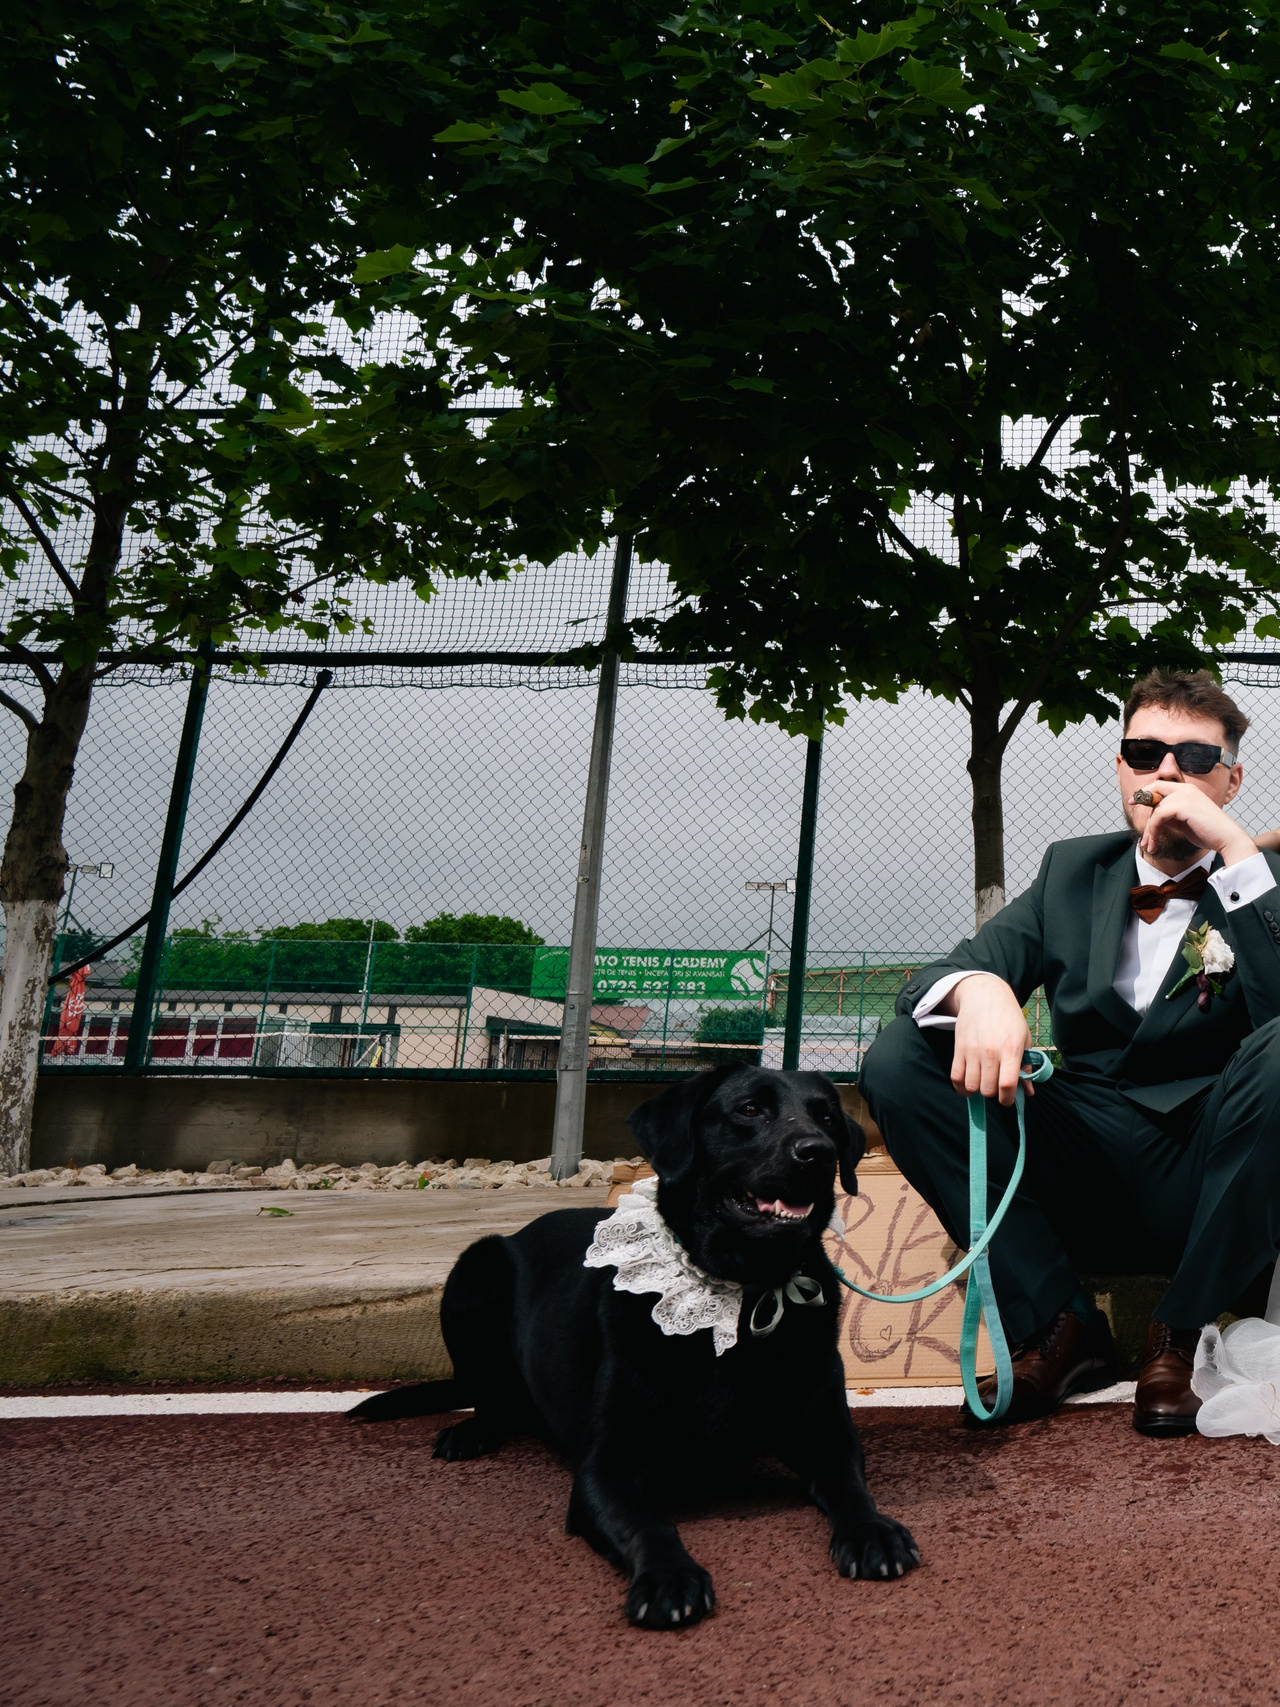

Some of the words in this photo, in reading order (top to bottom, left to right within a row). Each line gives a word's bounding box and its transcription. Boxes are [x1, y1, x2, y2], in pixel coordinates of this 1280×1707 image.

[621, 956, 660, 968] TENIS
[662, 957, 728, 969] ACADEMY
[617, 969, 637, 977] TENIS
